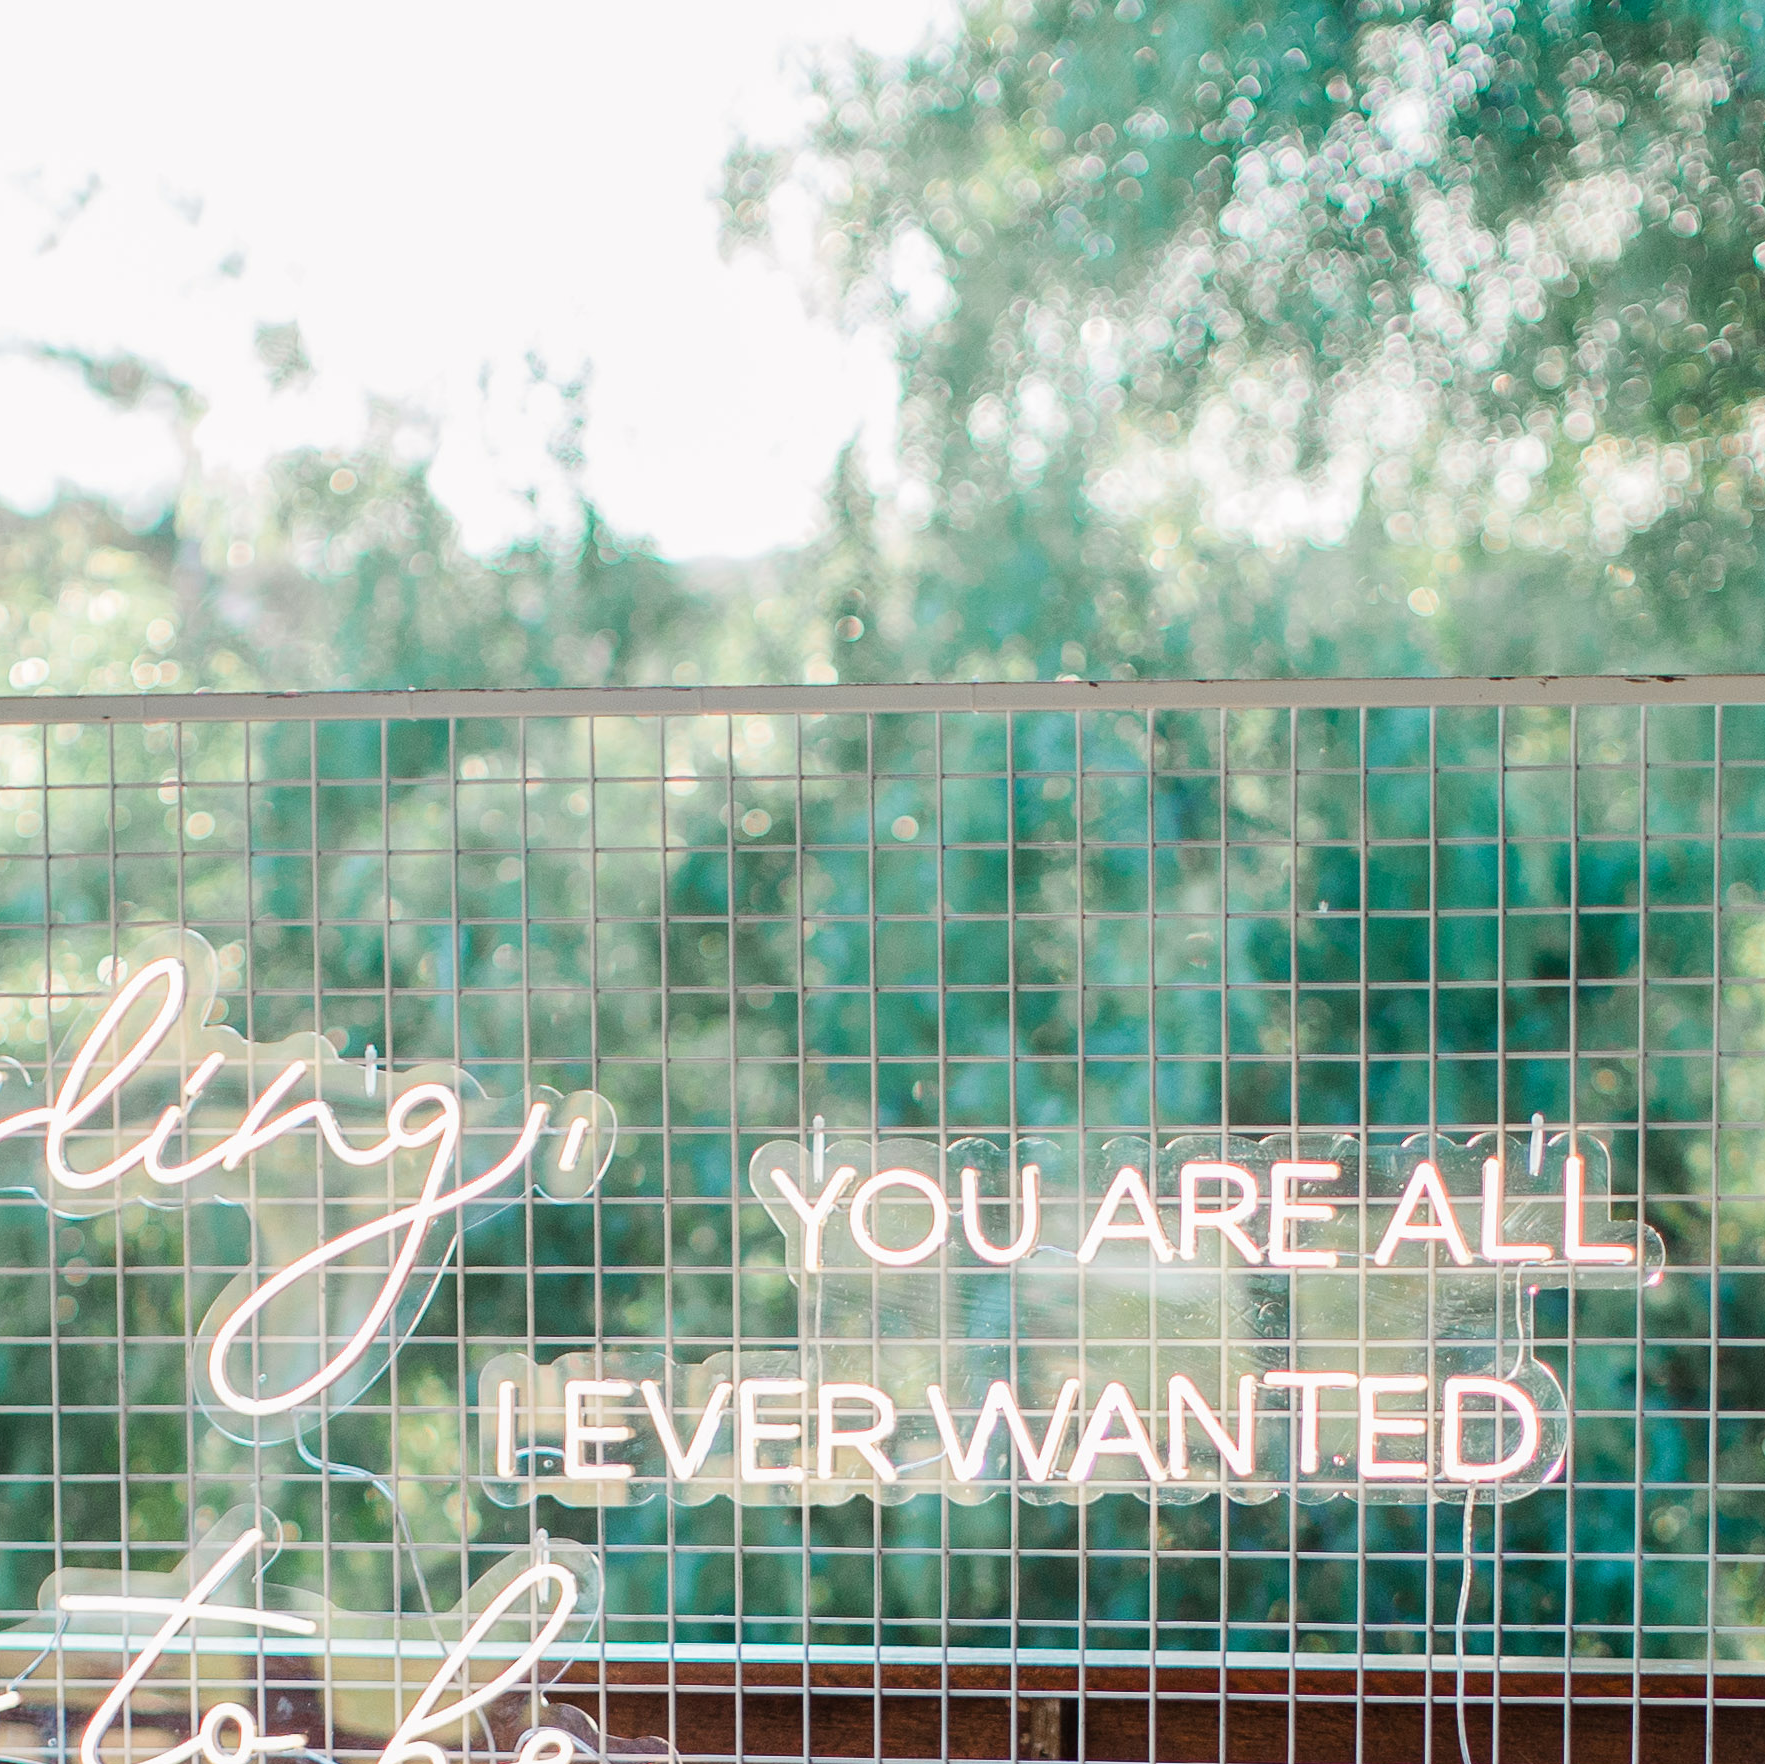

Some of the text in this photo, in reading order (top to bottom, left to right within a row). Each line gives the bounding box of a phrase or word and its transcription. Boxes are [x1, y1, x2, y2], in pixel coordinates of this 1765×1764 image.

[771, 1155, 1636, 1273] YOU ARE ALL
[497, 1370, 1540, 1484] I EVER WANTED
